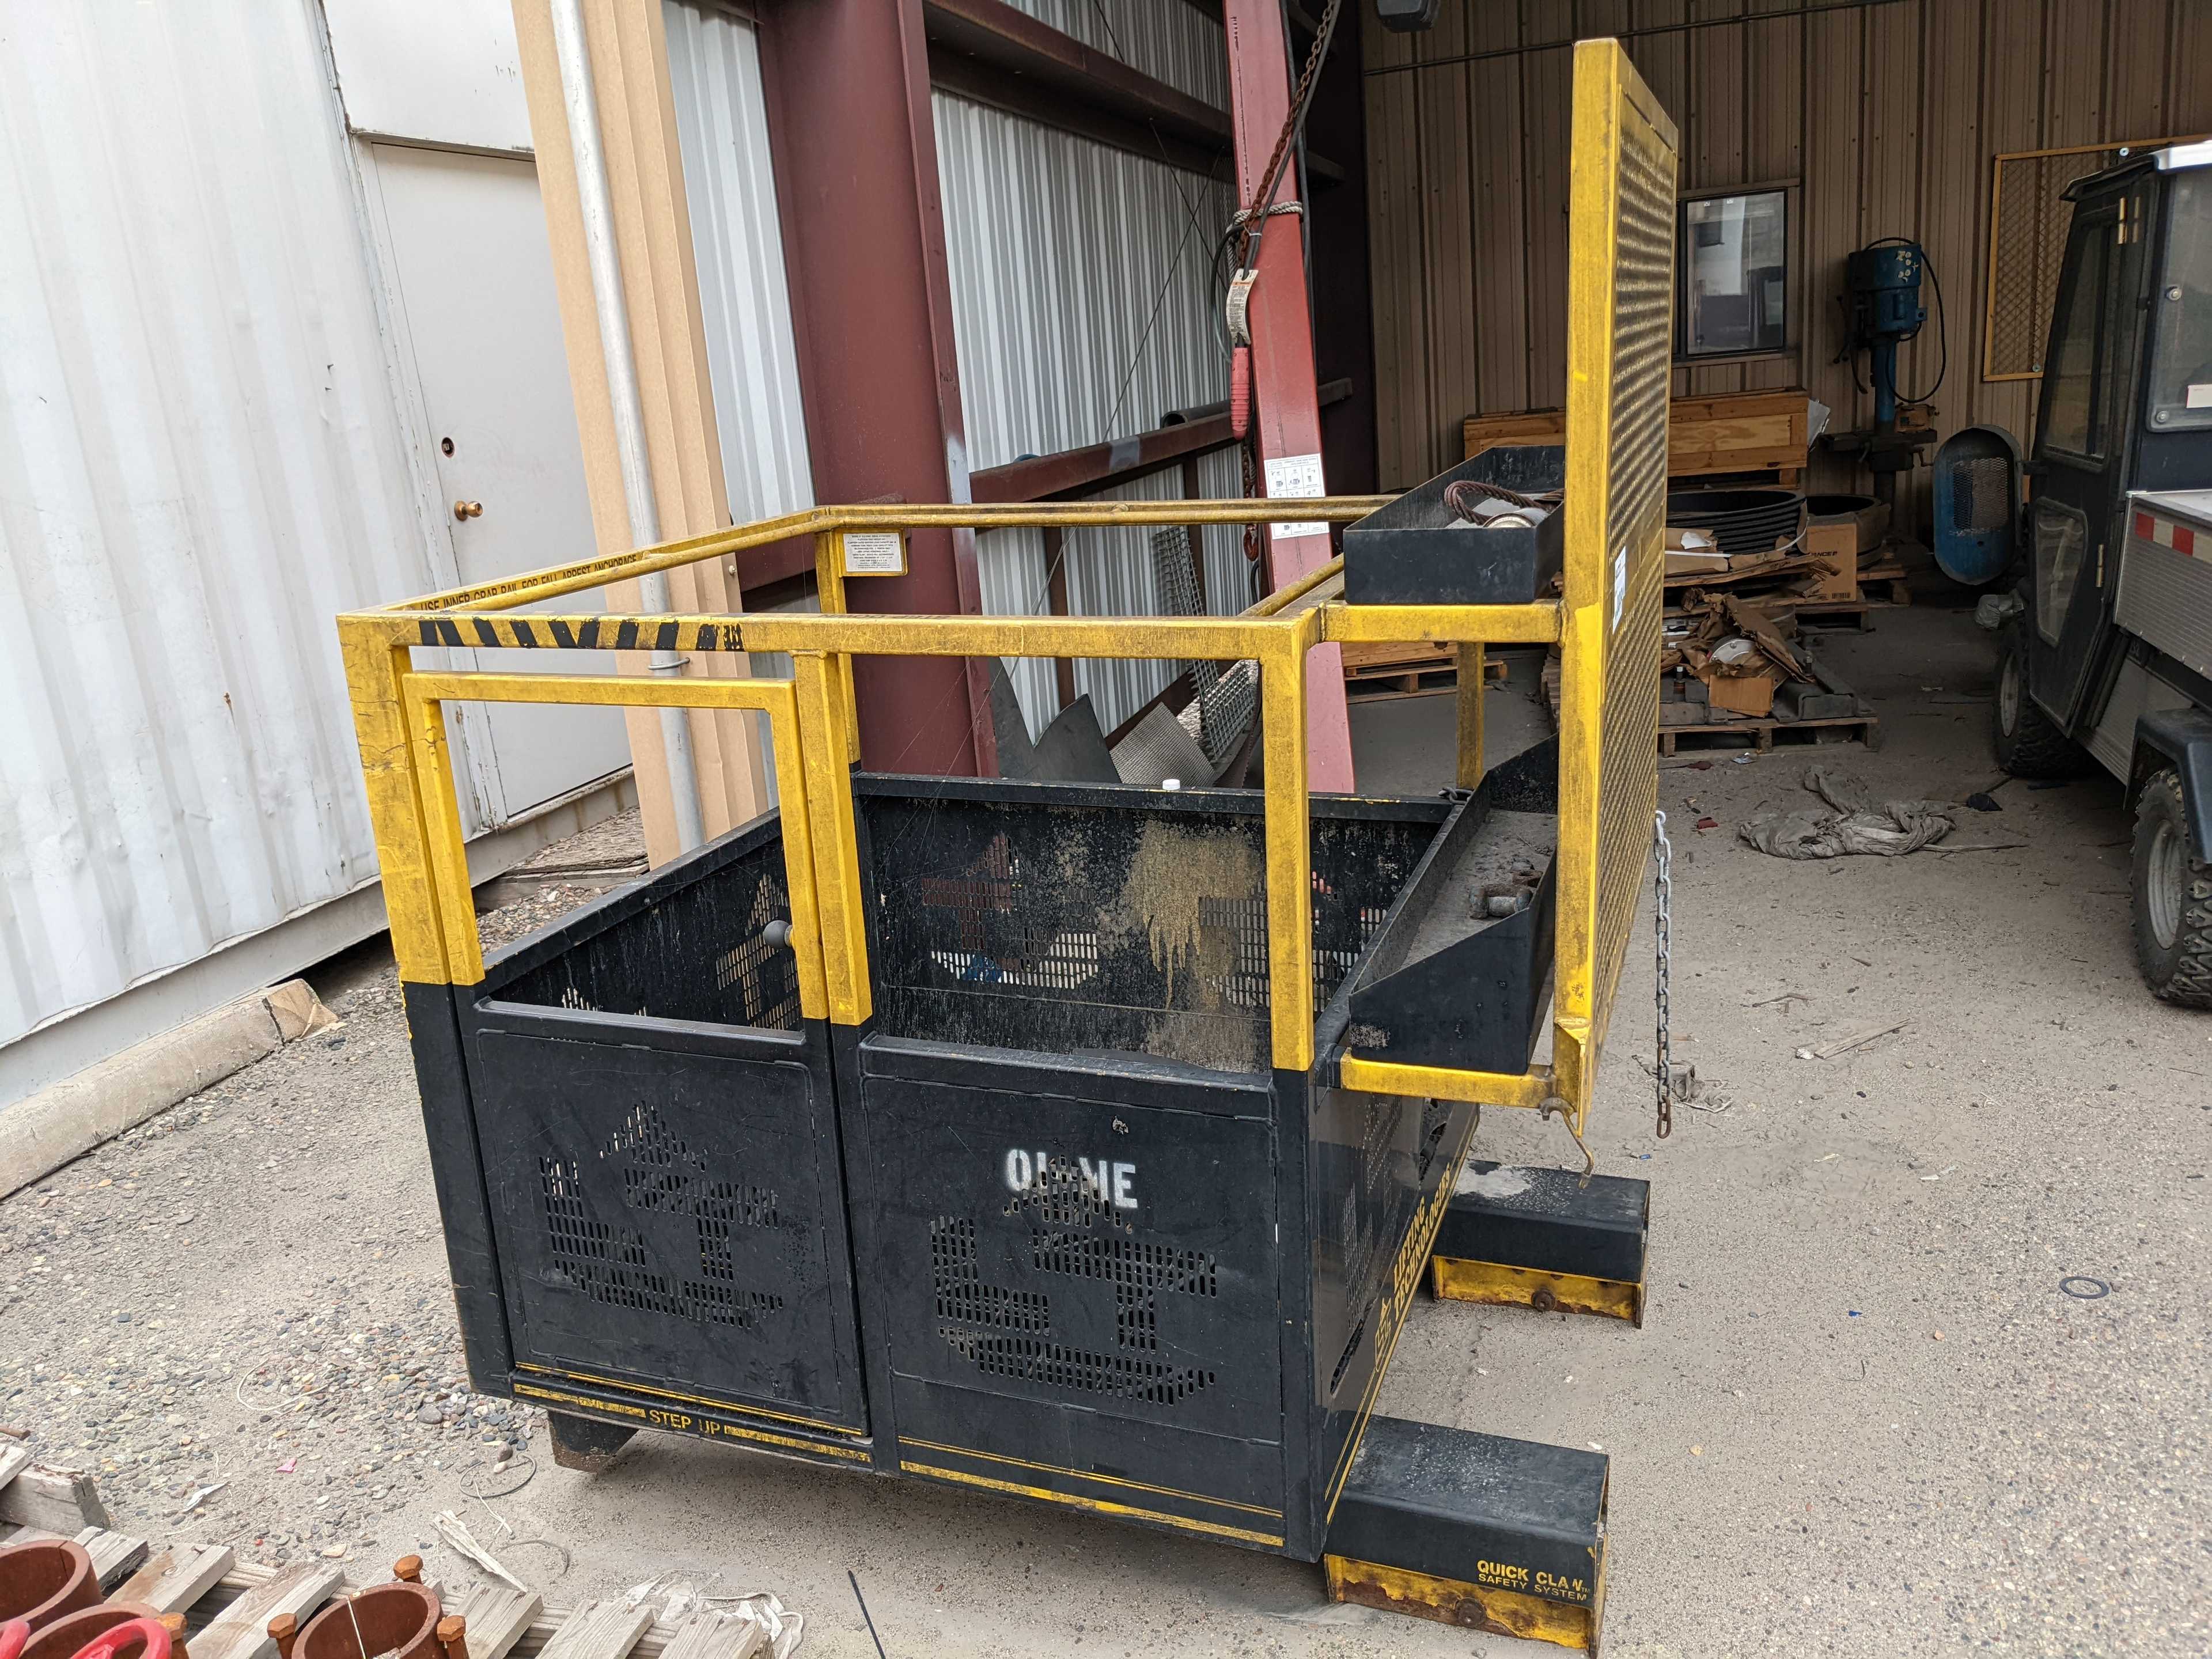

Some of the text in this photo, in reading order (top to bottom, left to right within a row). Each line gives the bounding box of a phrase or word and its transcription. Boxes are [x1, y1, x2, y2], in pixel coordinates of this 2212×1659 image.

[1394, 1162, 1450, 1322] TECHNOLOGIES
[1394, 1195, 1425, 1294] LIFTING
[649, 1410, 721, 1434] STEP UP
[1478, 1560, 1529, 1582] QUICK
[1479, 1573, 1588, 1601] SAFETY SYSTEM
